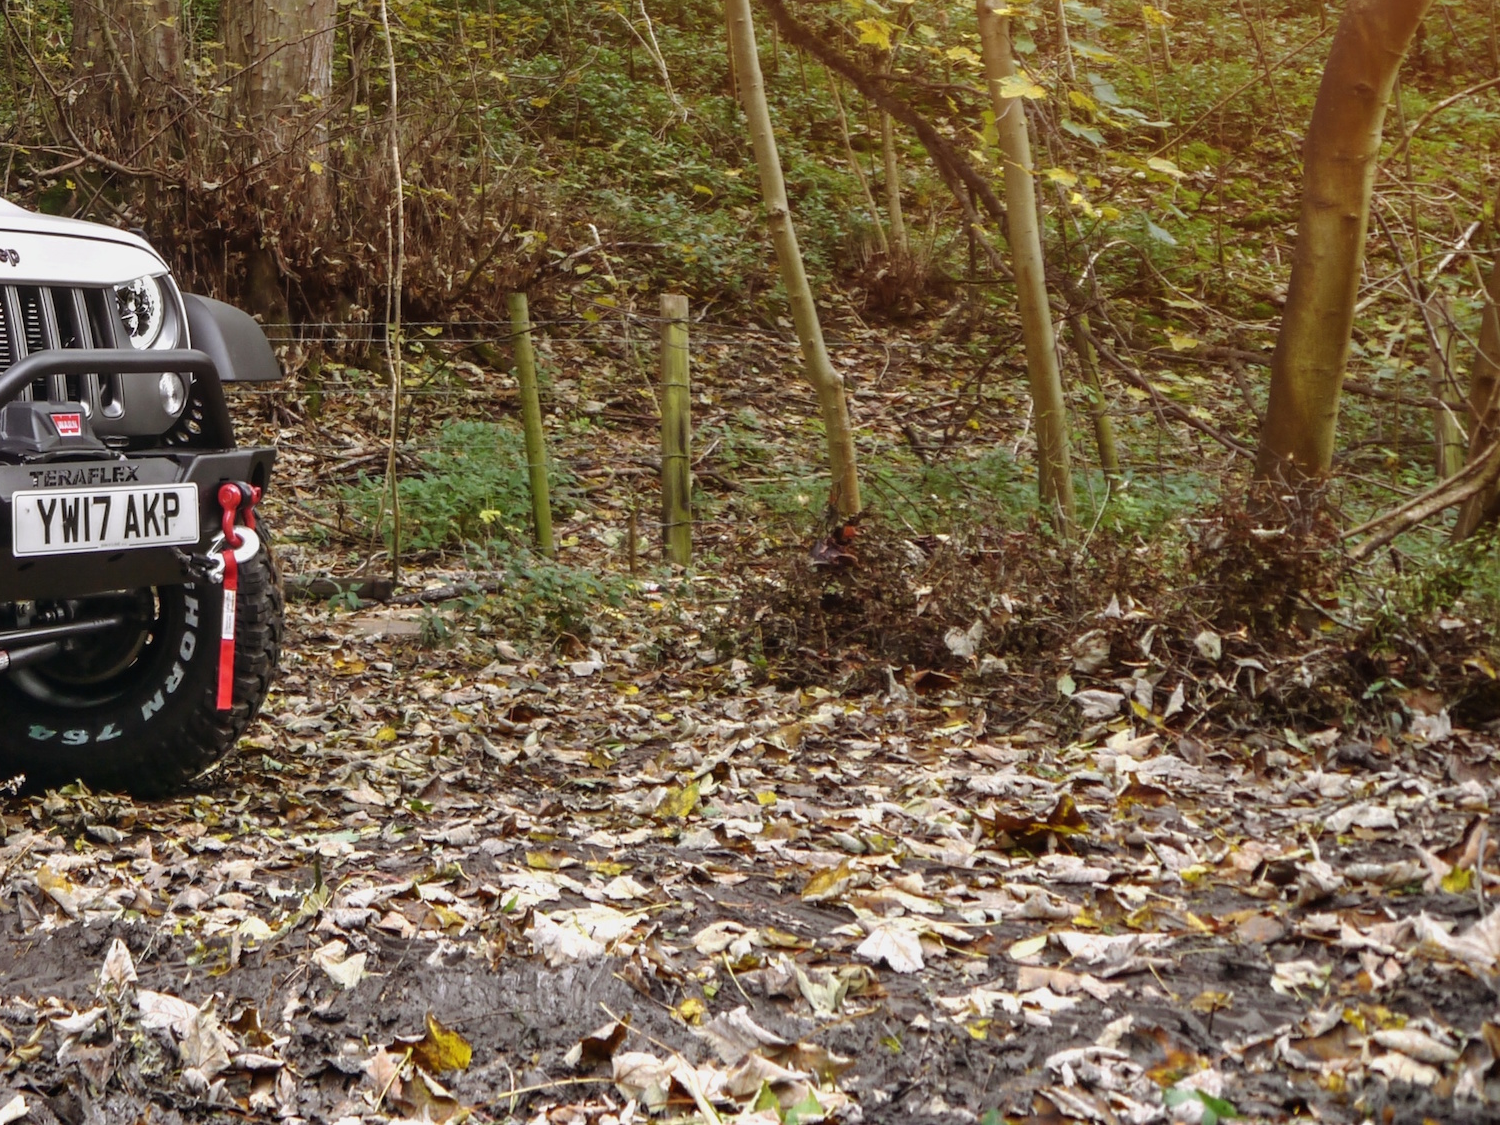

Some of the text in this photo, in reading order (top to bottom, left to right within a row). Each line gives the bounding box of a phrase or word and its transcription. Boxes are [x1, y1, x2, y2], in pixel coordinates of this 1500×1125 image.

[29, 465, 140, 487] TERAFLEX
[37, 492, 180, 545] YW17 AKP
[141, 582, 199, 721] HORN
